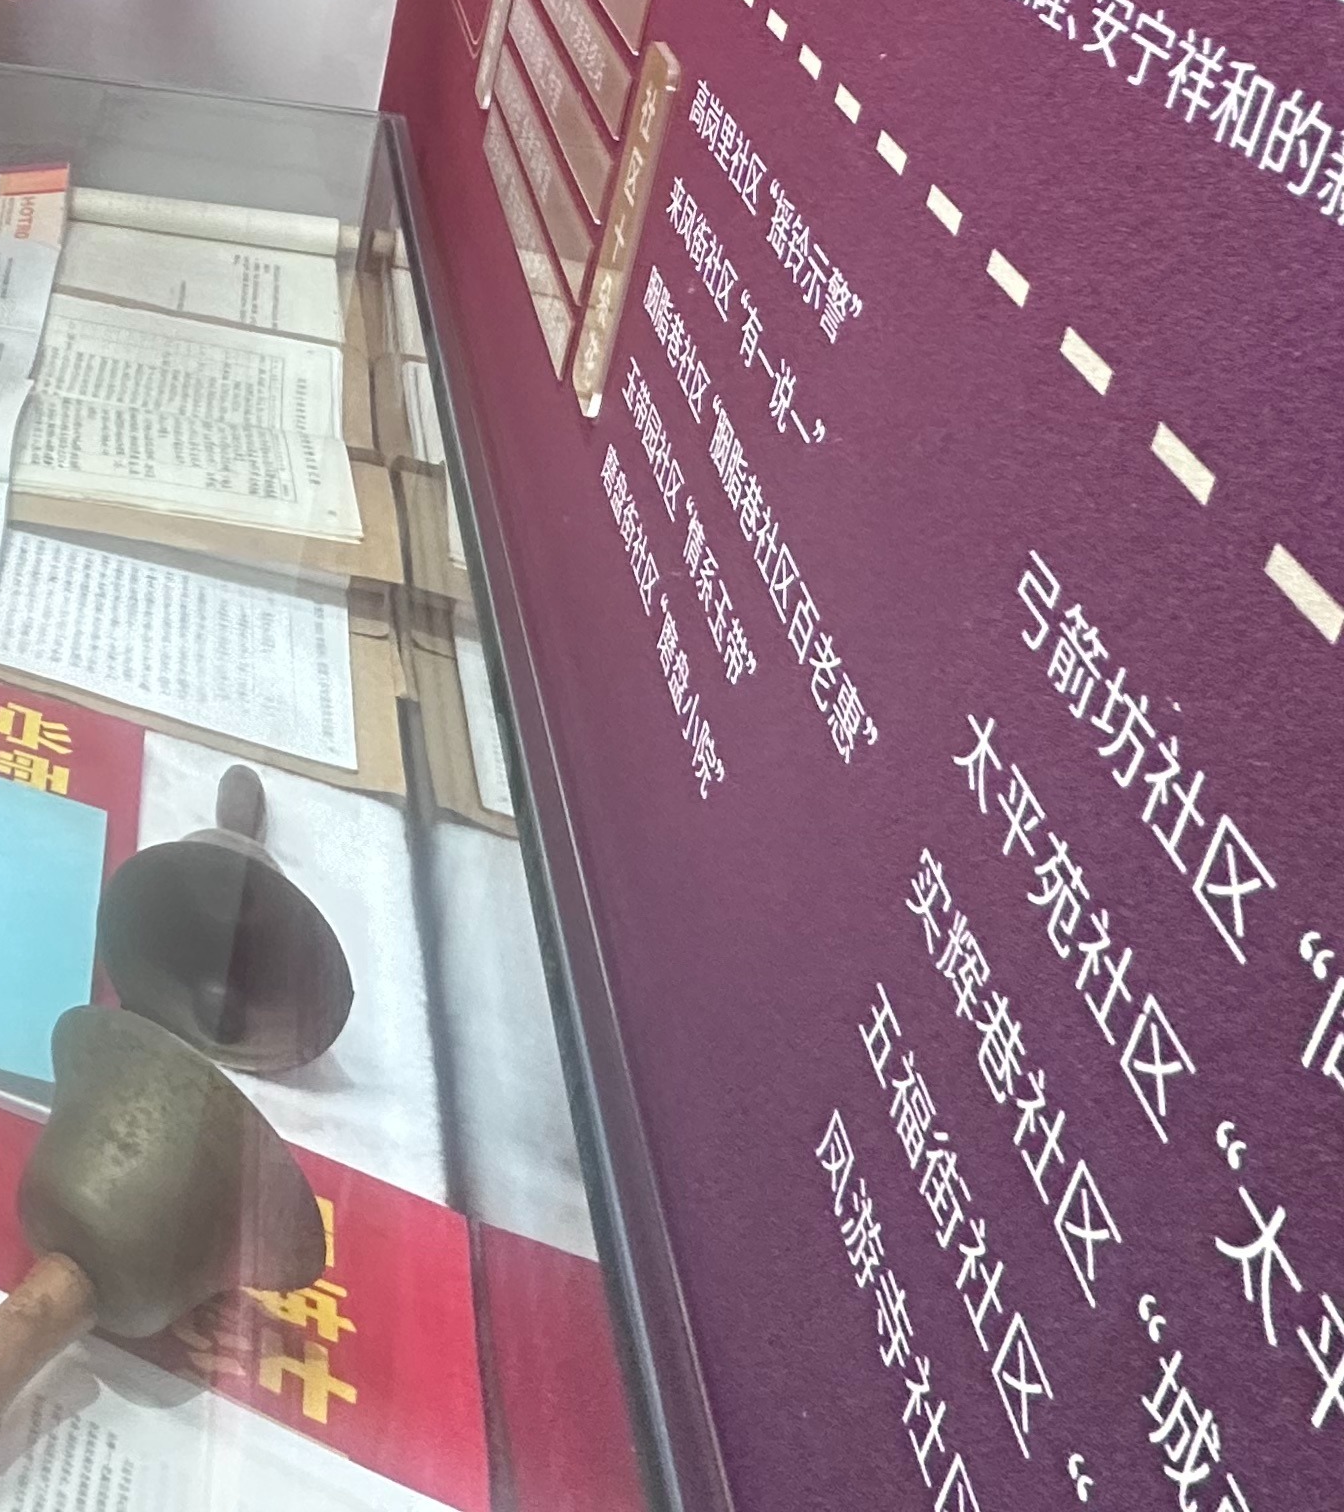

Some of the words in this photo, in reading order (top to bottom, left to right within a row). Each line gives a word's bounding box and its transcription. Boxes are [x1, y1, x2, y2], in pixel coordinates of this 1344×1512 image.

[665, 175, 739, 323] 来凤街社区
[688, 78, 768, 216] 高岗里社区
[600, 442, 661, 618] 磨盘街社区
[620, 355, 686, 523] 玉带园社区
[1018, 549, 1277, 965] 弓箭坊社区
[953, 713, 1197, 1144] 太平苑社区
[859, 981, 1055, 1459] 五福街社区
[906, 847, 1122, 1309] 实辉巷社区
